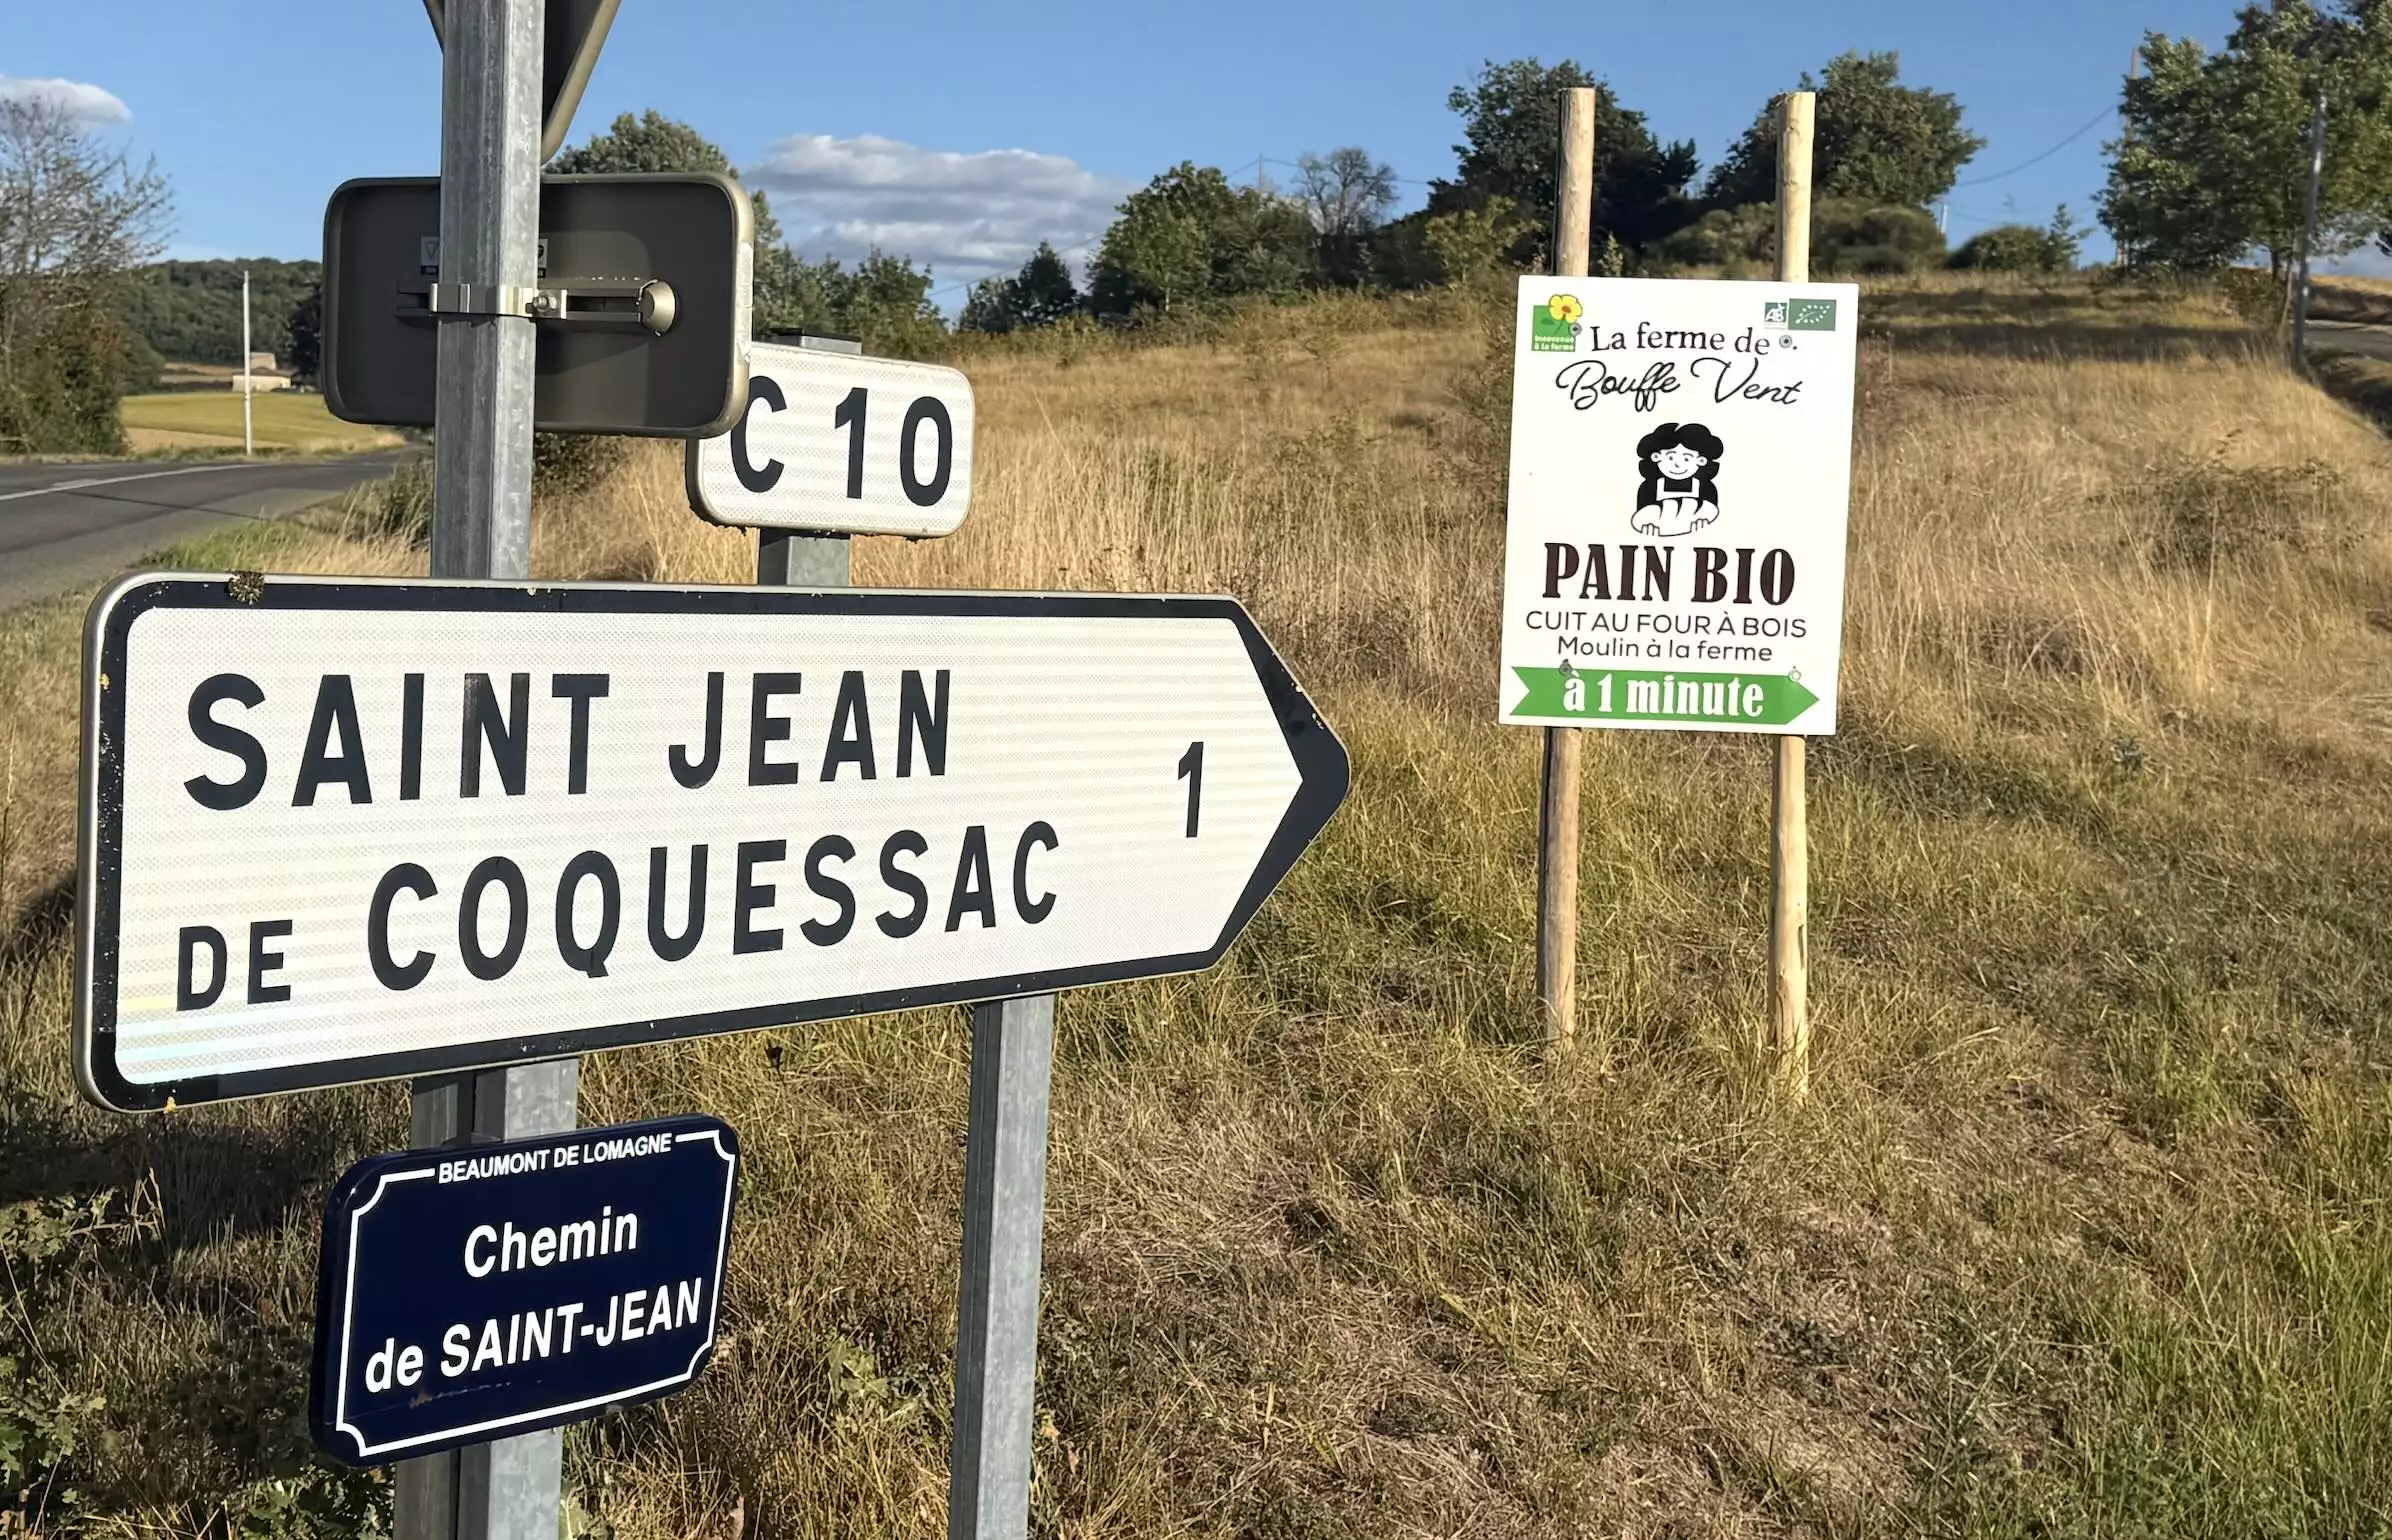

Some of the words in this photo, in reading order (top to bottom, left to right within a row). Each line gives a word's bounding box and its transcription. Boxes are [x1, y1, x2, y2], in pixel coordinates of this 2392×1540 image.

[1589, 325, 1627, 352] La
[1636, 321, 1725, 351] ferme
[1734, 326, 1770, 355] de
[1555, 359, 1681, 413] Bouffe
[1690, 357, 1803, 405] Vent
[730, 375, 787, 493] C
[1542, 542, 1675, 602] PAIN
[1690, 546, 1795, 606] BIO
[1526, 610, 1587, 631] CUIT
[1591, 612, 1629, 633] AU
[1637, 613, 1711, 635] FOUR
[1717, 610, 1736, 636] À
[1743, 617, 1807, 638] BOIS
[1557, 635, 1639, 657] Moulin
[1646, 638, 1661, 659] à
[1669, 639, 1690, 659] la
[1697, 640, 1773, 662] ferme
[1563, 669, 1585, 712] à
[1597, 673, 1613, 713] 1
[1625, 674, 1765, 717] minute
[183, 672, 610, 811] SAINT
[668, 669, 951, 790] JEAN
[1177, 741, 1204, 838] 1
[176, 919, 293, 1012] DE
[367, 820, 1059, 991] COQUESSAC
[438, 1150, 550, 1184] BEAUMONT
[553, 1145, 579, 1168] DE
[583, 1133, 672, 1164] LOMAGNE
[464, 1206, 638, 1278] Chemin
[365, 1338, 424, 1393] de
[440, 1277, 702, 1378] SAINT-JEAN
